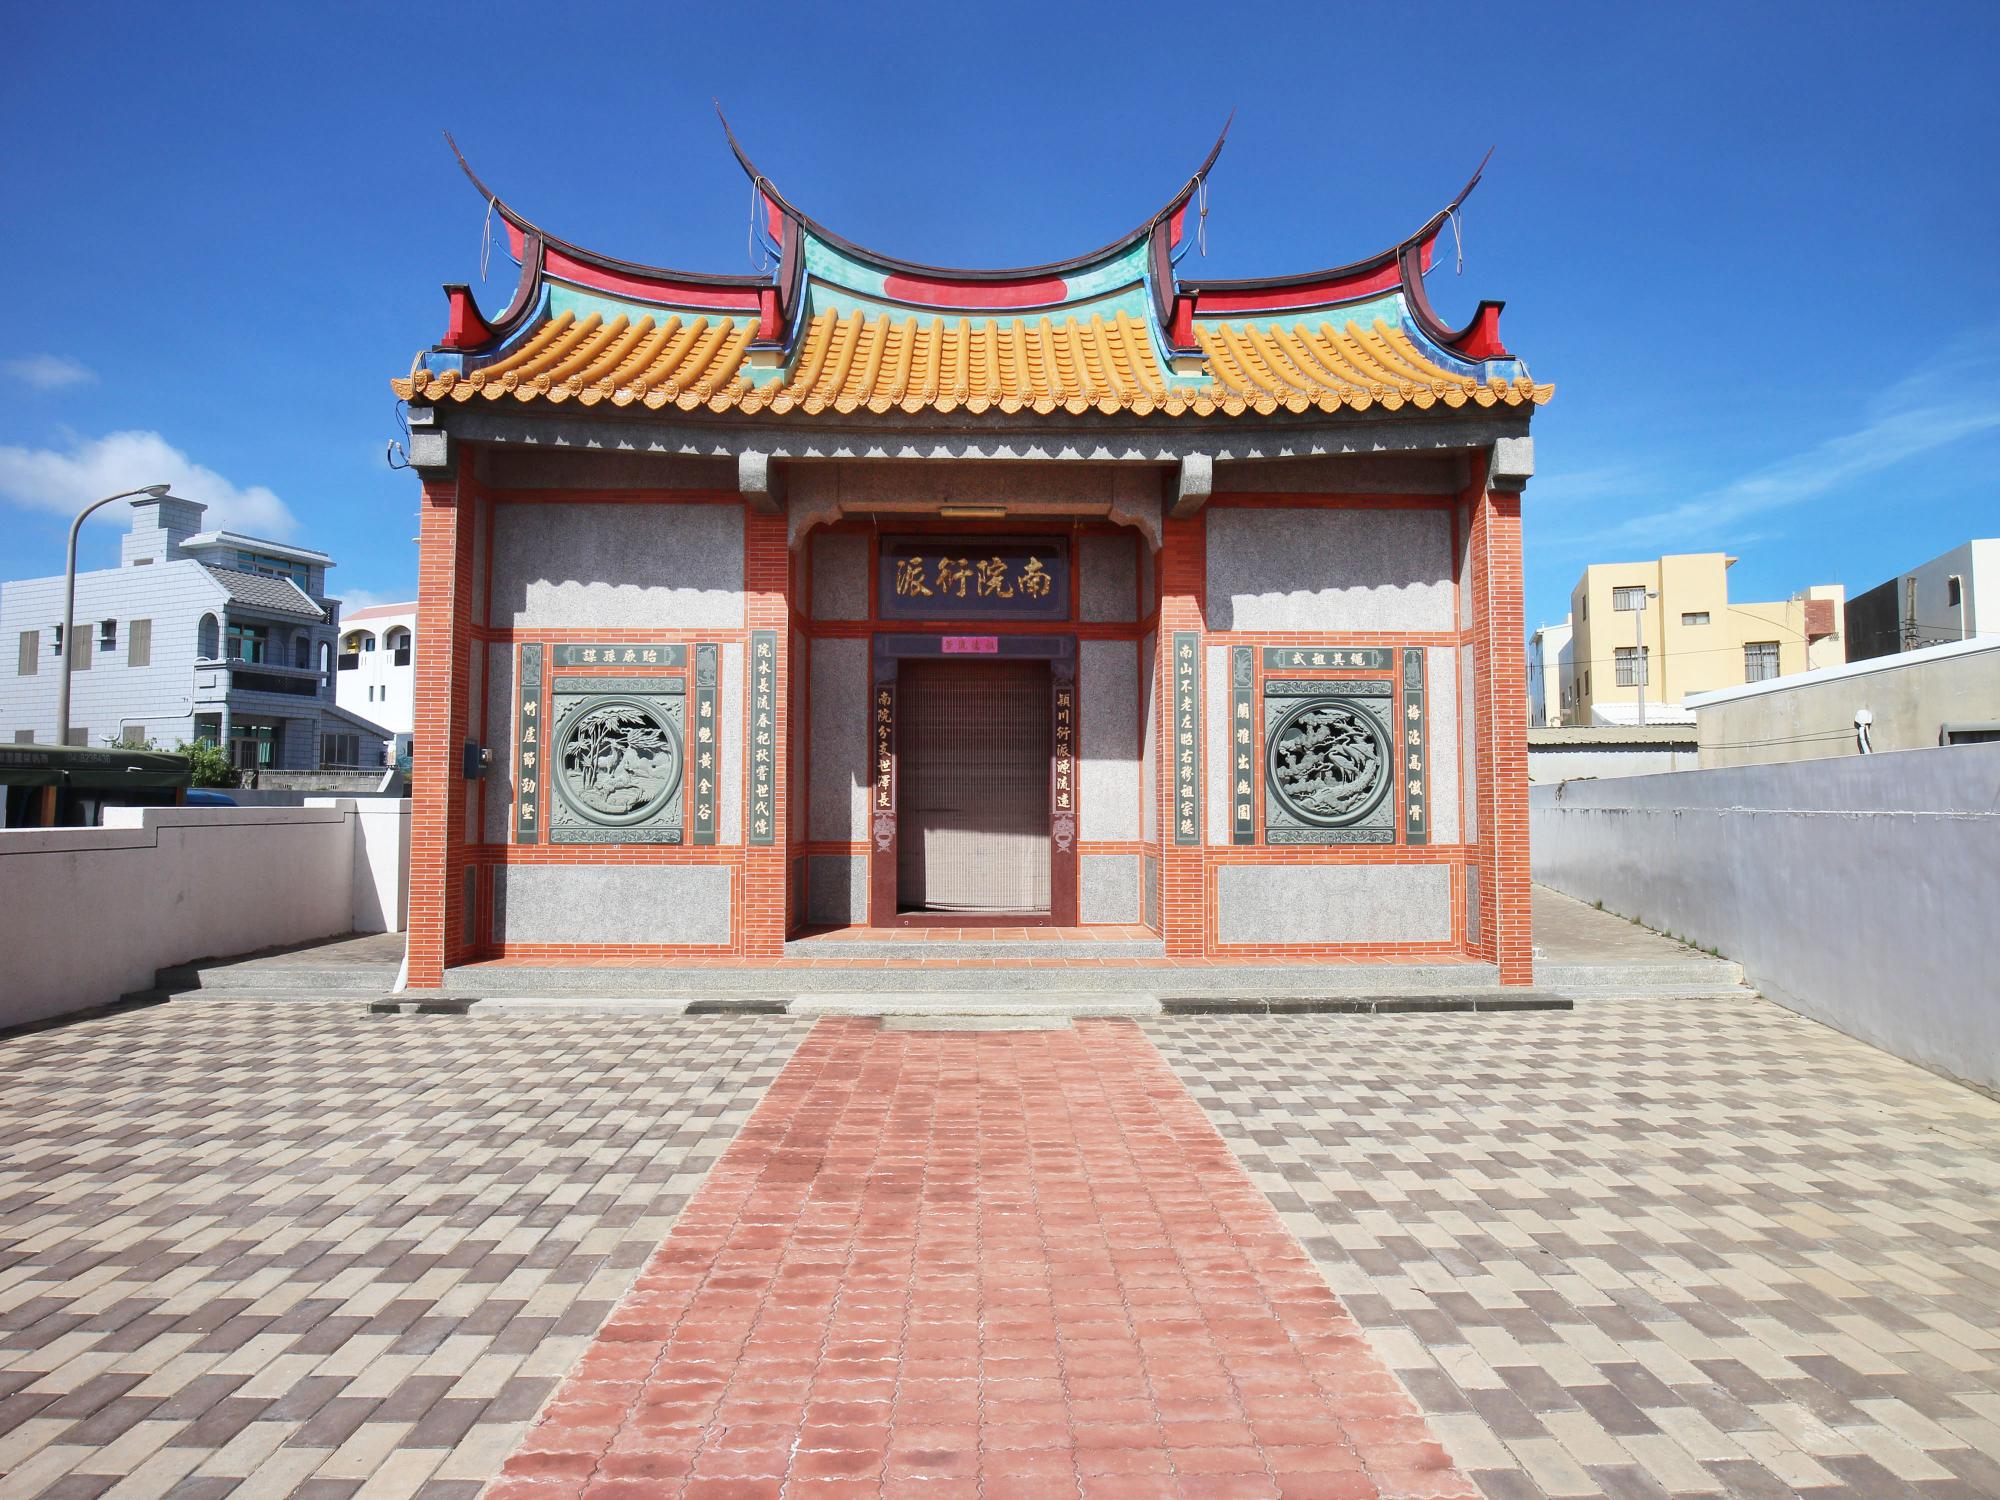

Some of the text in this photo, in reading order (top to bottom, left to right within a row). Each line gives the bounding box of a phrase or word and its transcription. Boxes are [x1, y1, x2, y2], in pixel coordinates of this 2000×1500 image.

[582, 649, 657, 663] 貽厥孫謀
[1292, 651, 1366, 666] 繩其祖武
